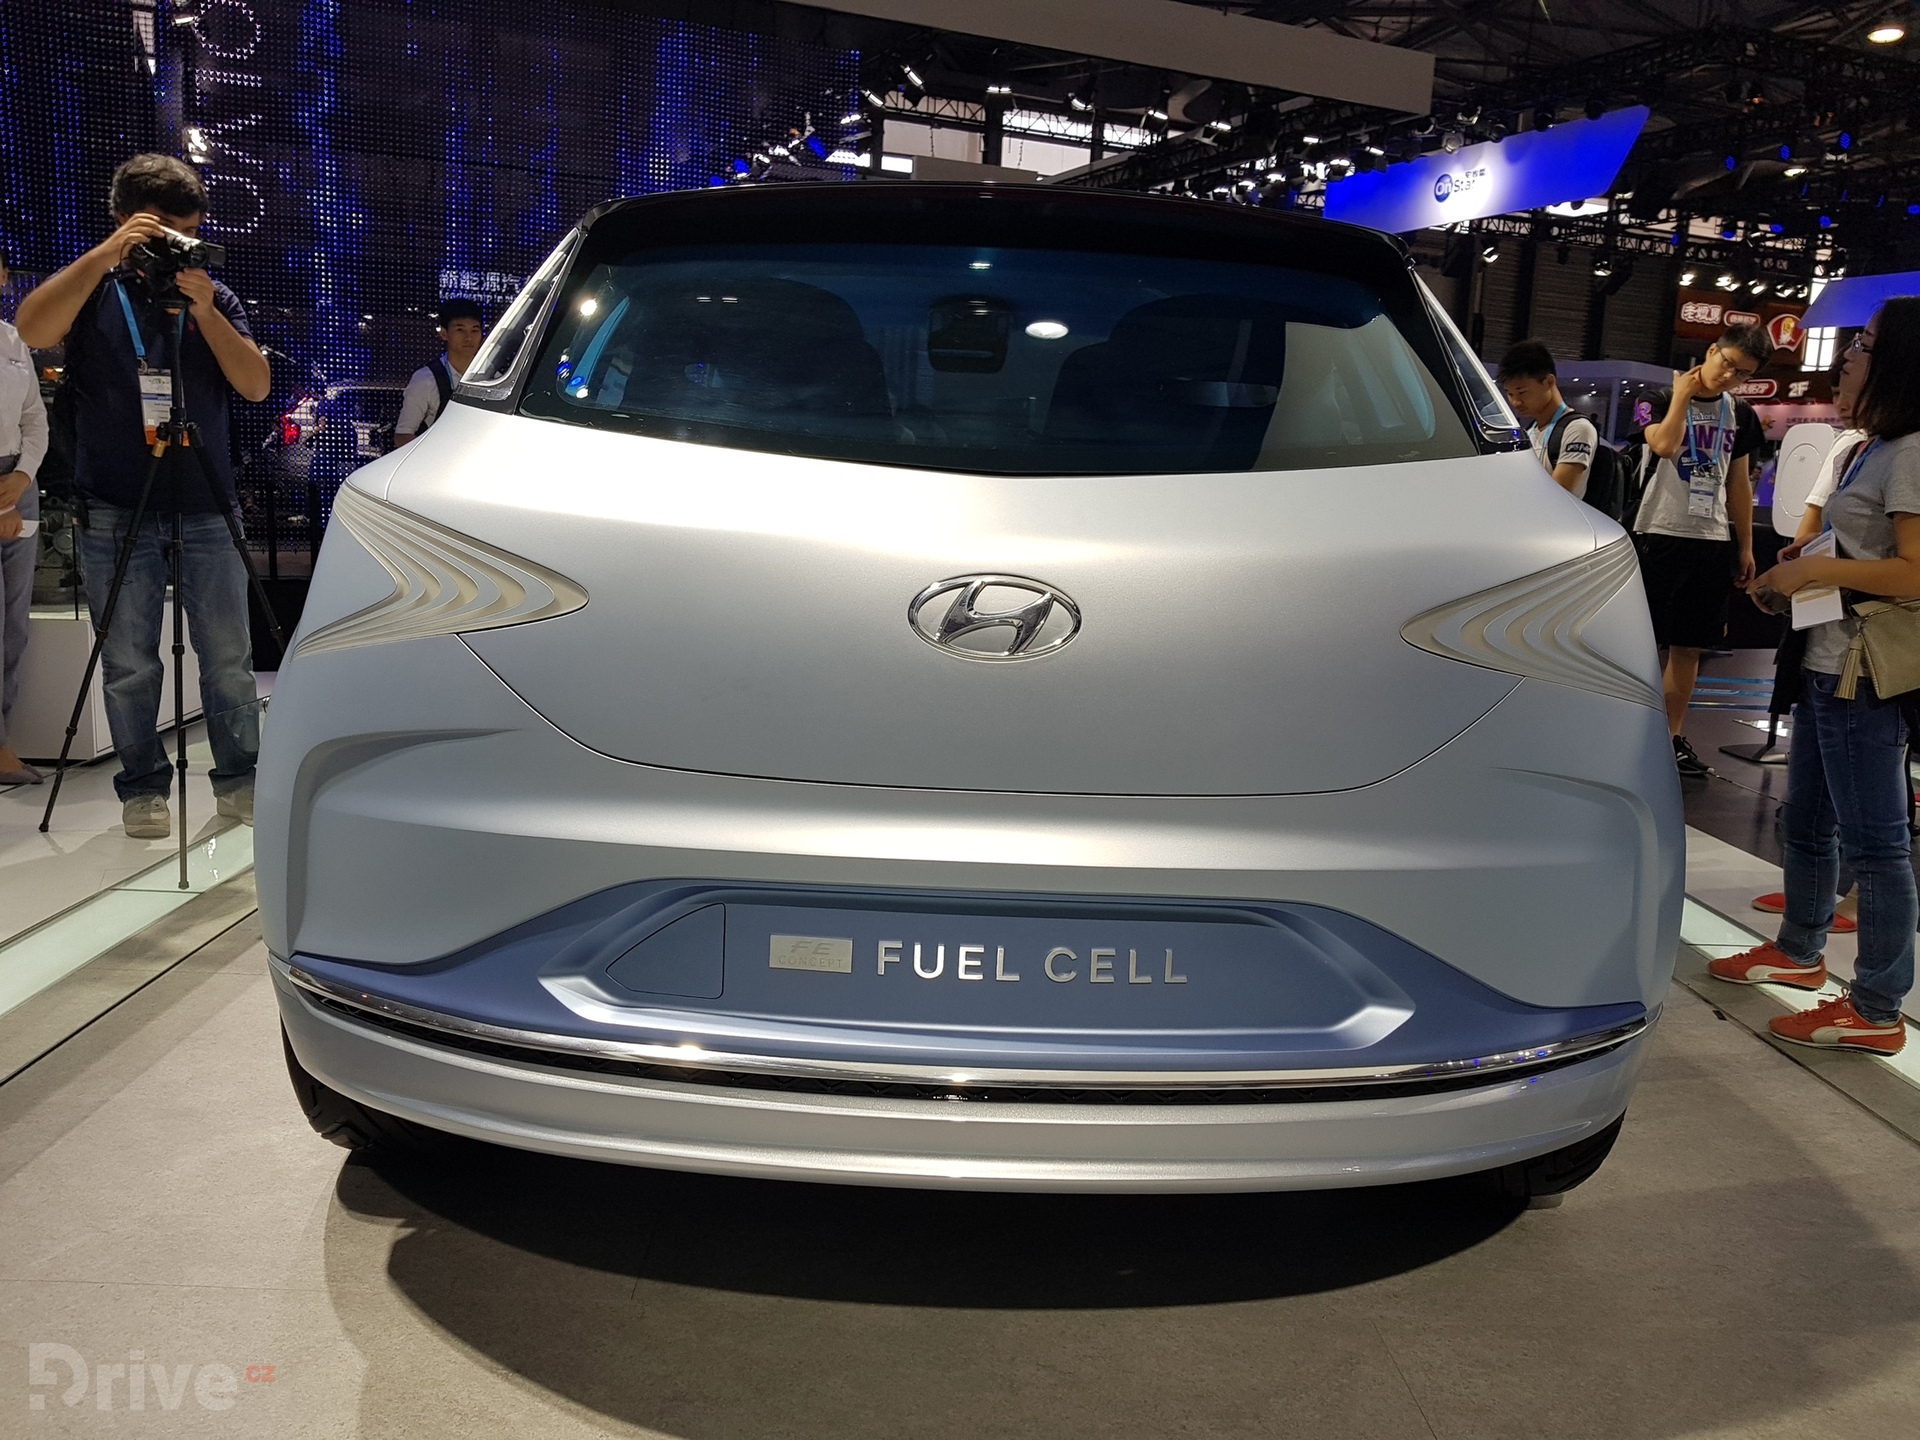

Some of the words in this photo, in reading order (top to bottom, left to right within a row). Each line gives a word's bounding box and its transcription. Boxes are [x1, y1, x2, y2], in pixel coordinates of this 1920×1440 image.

[439, 268, 531, 294] 新能源汽
[1788, 381, 1809, 398] 2F
[790, 940, 834, 955] FE
[778, 954, 843, 969] CONCEPT
[876, 940, 1020, 982] FUEL
[1043, 946, 1188, 984] CELL
